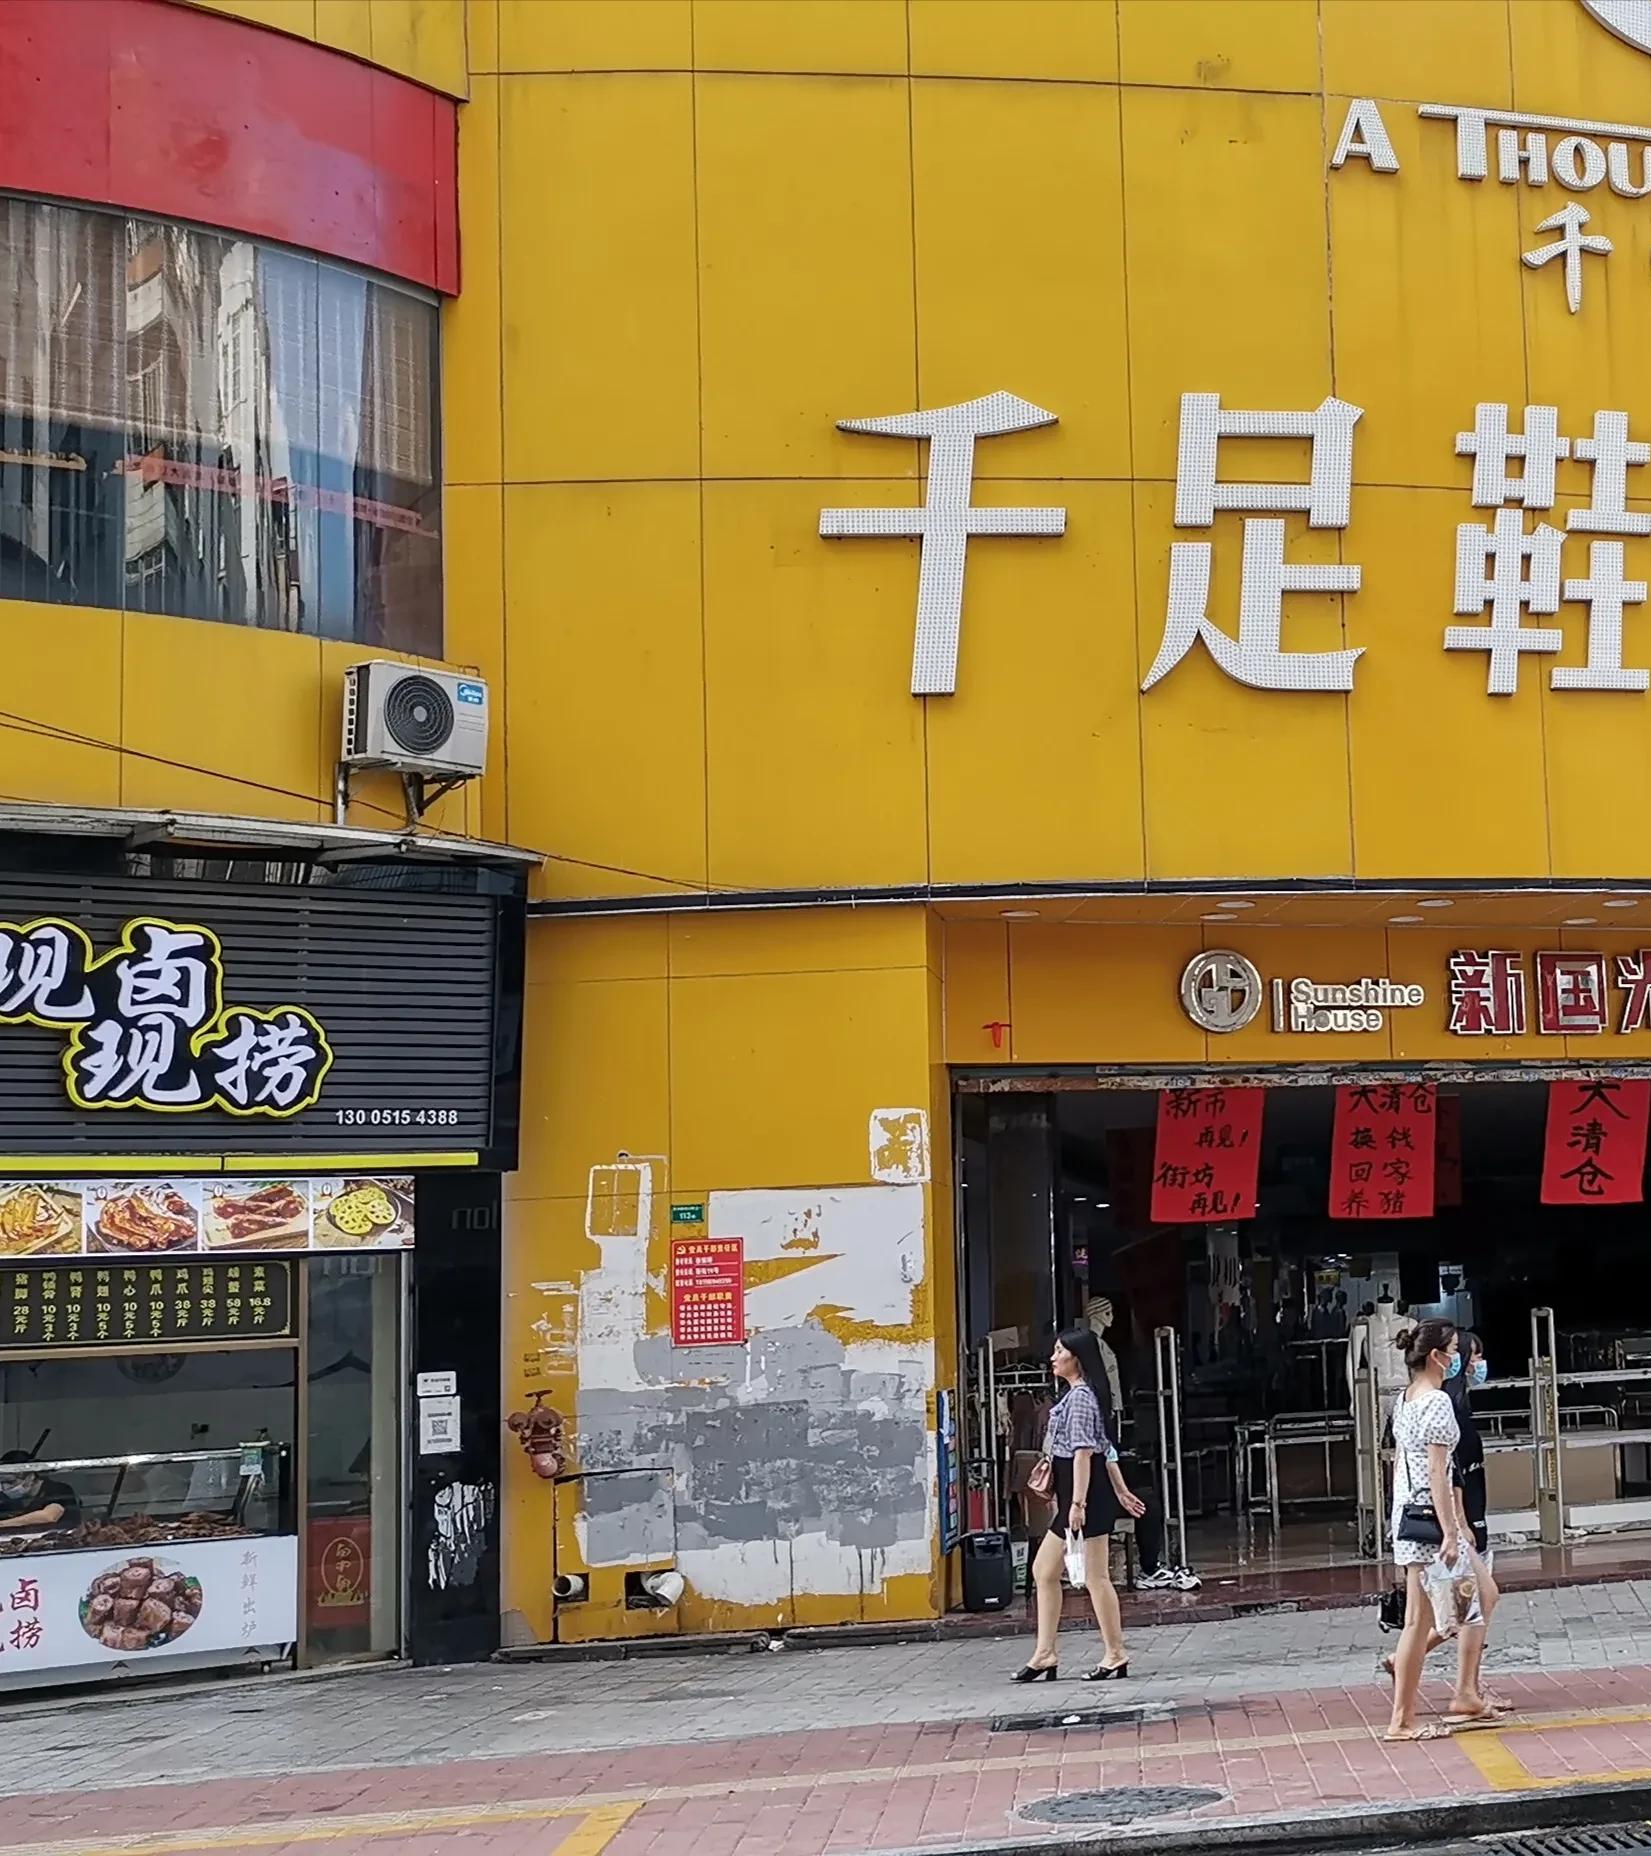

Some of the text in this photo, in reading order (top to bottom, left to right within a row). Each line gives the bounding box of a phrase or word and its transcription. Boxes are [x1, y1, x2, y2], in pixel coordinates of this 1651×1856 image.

[1331, 99, 1400, 173] A
[1291, 977, 1424, 1006] Sunshine
[1291, 1003, 1383, 1032] House
[80, 1014, 317, 1106] 现捞
[1165, 1089, 1227, 1120] 新市
[1348, 1083, 1435, 1115] 大清仓
[335, 1109, 458, 1126] 130 0515 4388
[1560, 1080, 1632, 1196] 大清仓
[1152, 1161, 1215, 1189] 街坊
[1349, 1158, 1414, 1186] 回家
[1341, 1188, 1407, 1217] 养猪
[0, 1578, 39, 1612] 卤
[0, 1616, 43, 1652] 捞
